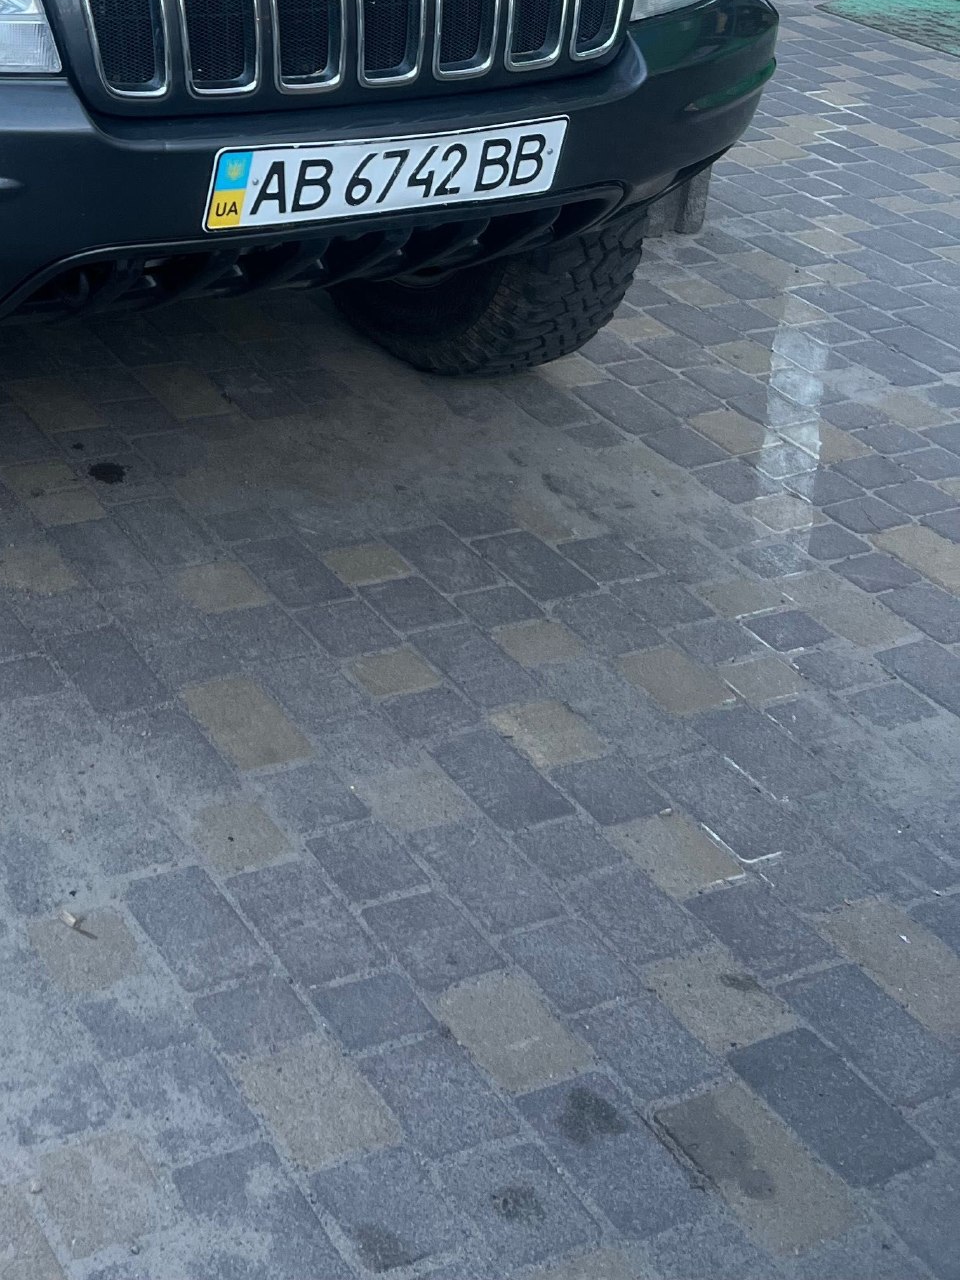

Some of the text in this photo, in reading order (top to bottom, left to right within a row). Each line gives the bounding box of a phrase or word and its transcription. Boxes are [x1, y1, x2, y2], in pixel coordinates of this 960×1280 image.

[249, 133, 547, 216] AB 6742 BB
[214, 199, 239, 217] UA
